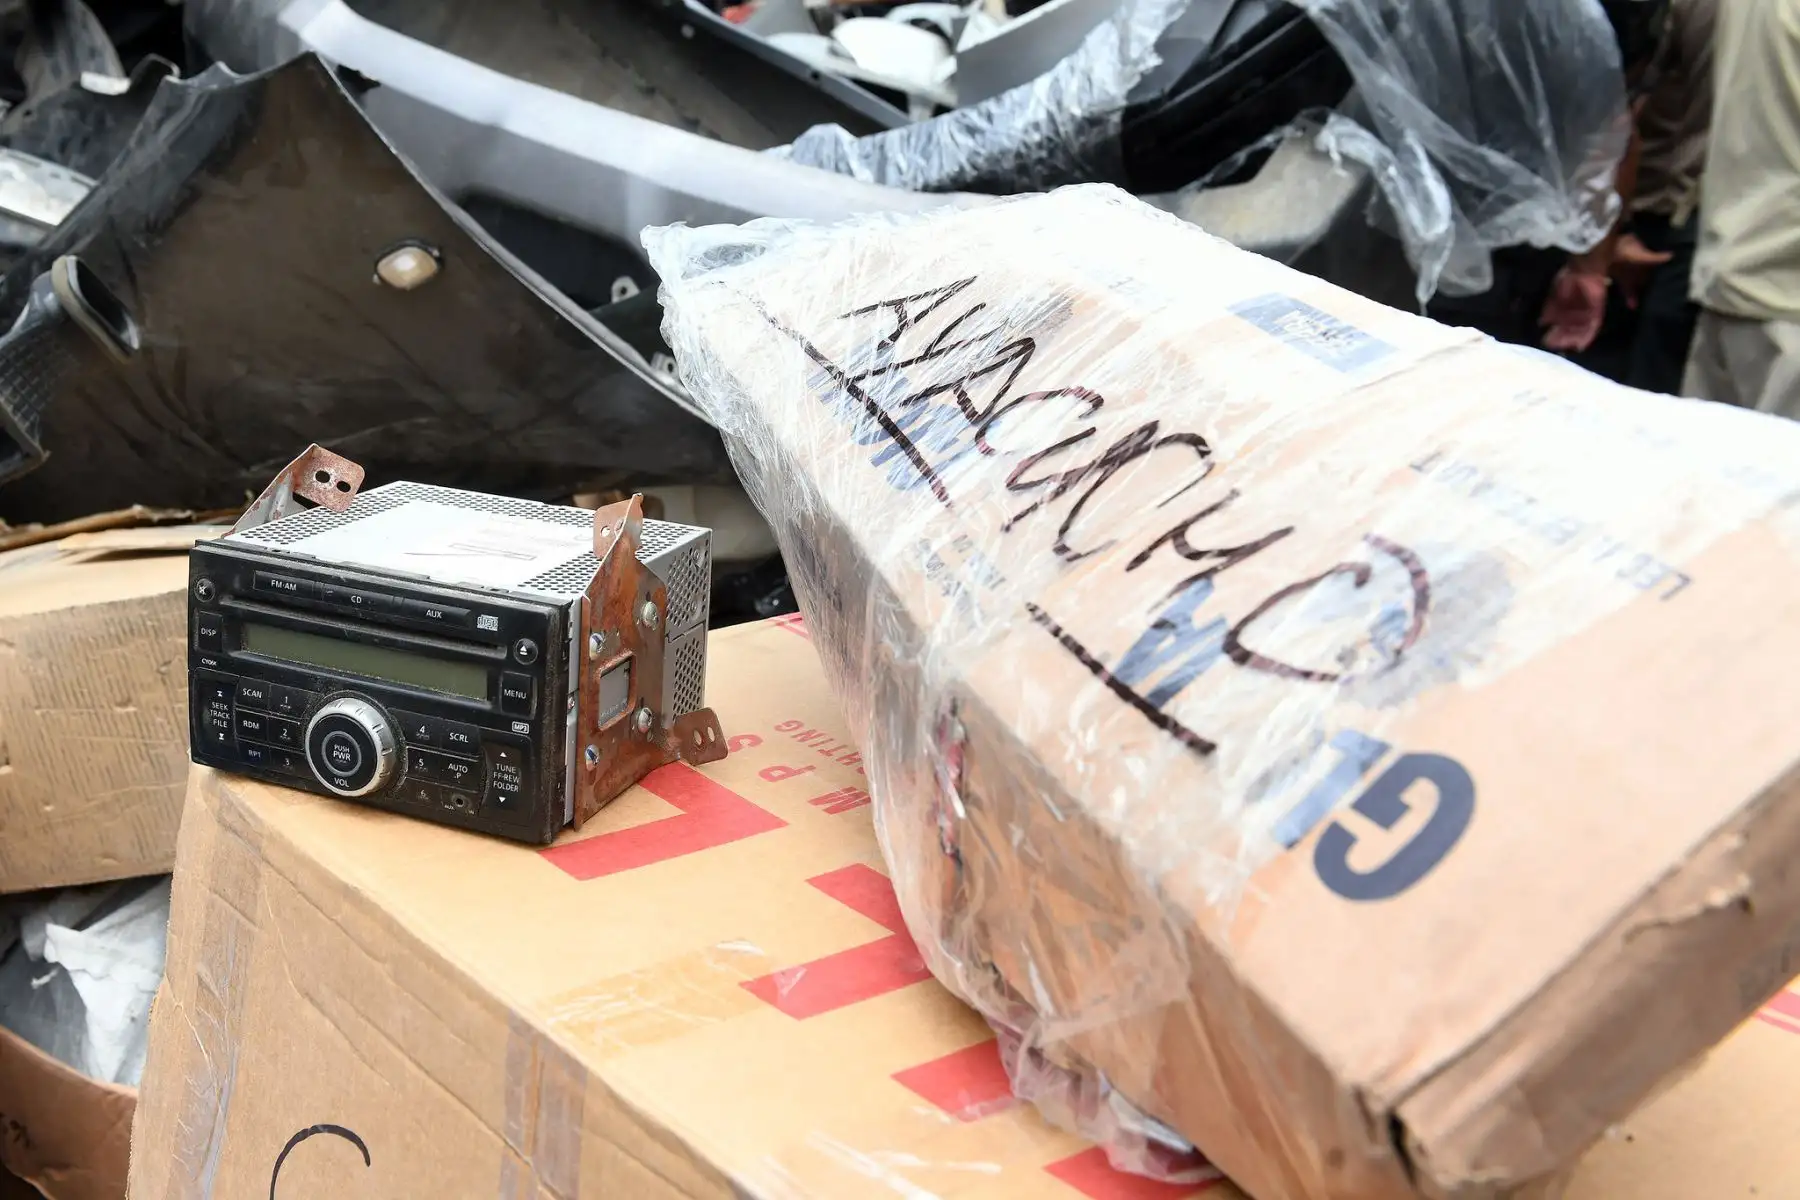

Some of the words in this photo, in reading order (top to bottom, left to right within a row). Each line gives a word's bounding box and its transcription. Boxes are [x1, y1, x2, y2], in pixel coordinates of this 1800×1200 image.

[350, 595, 362, 604] CD
[425, 609, 442, 619] AUX
[200, 627, 217, 637] DISP
[242, 688, 263, 699] SCAN
[504, 688, 527, 699] MENU
[211, 701, 228, 711] SEEK
[210, 709, 231, 719] TRACK
[213, 718, 228, 728] FILE
[243, 720, 260, 730] RDM
[513, 723, 529, 733] MP3
[449, 732, 469, 743] SCRL
[334, 744, 350, 753] PUSH
[774, 719, 865, 775] HTING
[333, 750, 351, 761] PWR
[447, 763, 469, 773] AUTO
[495, 763, 517, 774] TUNE
[333, 777, 350, 788] VOL
[493, 780, 519, 792] FOLDER
